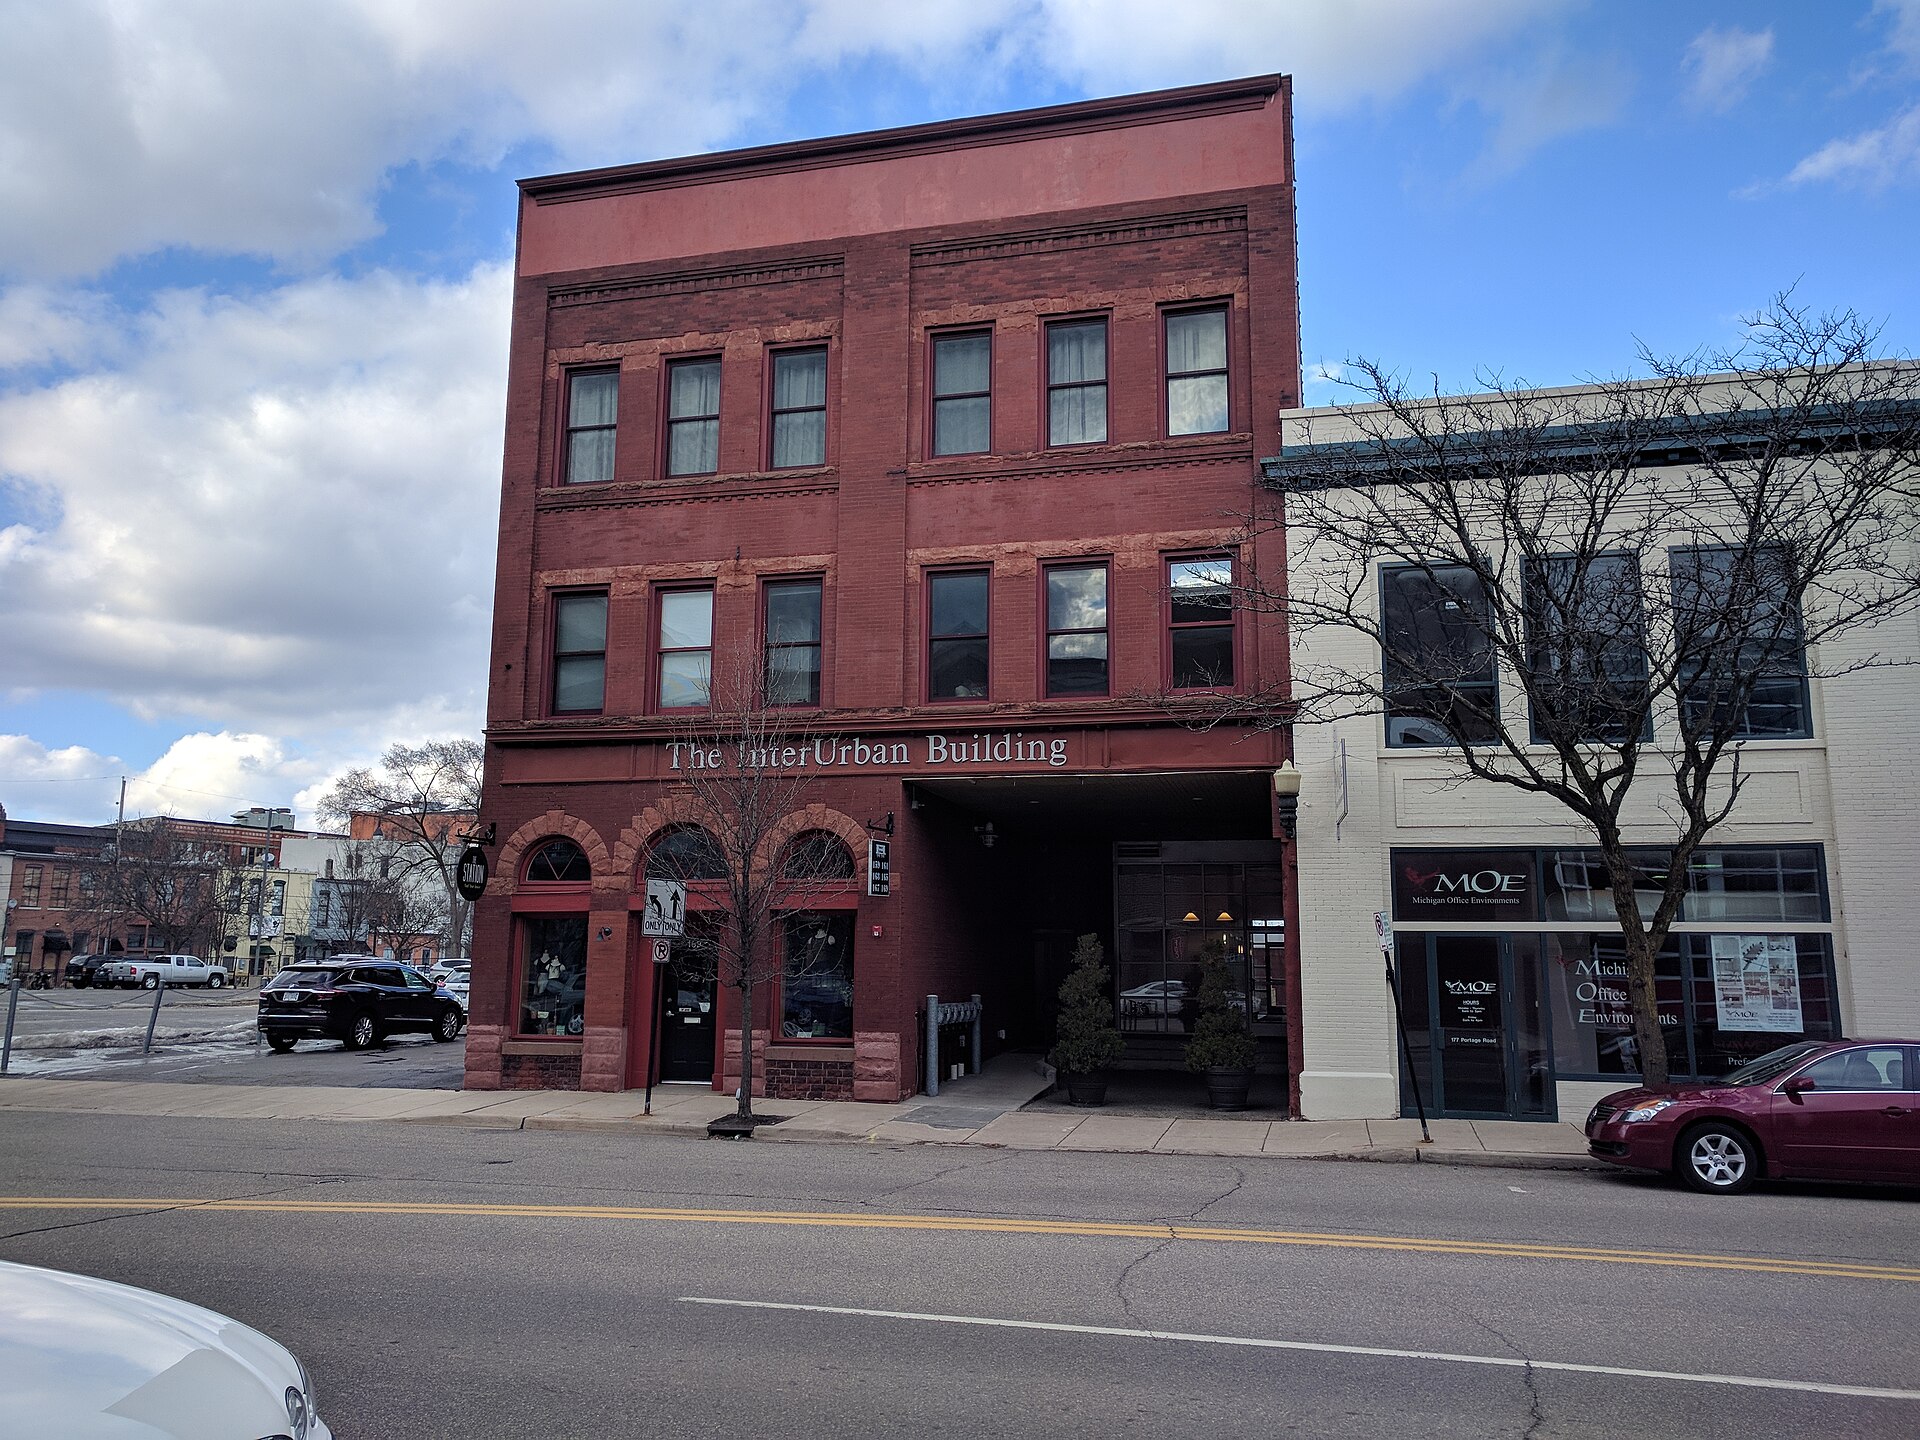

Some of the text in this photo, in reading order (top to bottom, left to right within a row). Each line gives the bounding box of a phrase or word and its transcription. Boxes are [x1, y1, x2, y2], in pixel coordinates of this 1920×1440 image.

[665, 732, 1068, 769] The InterUrban Building
[463, 863, 485, 883] STATION
[1433, 870, 1527, 893] MOE
[1412, 896, 1520, 905] Michigan Office Environments
[645, 920, 682, 932] ONLY ONLY
[1575, 959, 1630, 978] Michi
[1457, 980, 1497, 992] MOE
[1576, 982, 1628, 1002] Office
[1578, 1008, 1679, 1026] Environts
[1734, 1010, 1758, 1019] MOE
